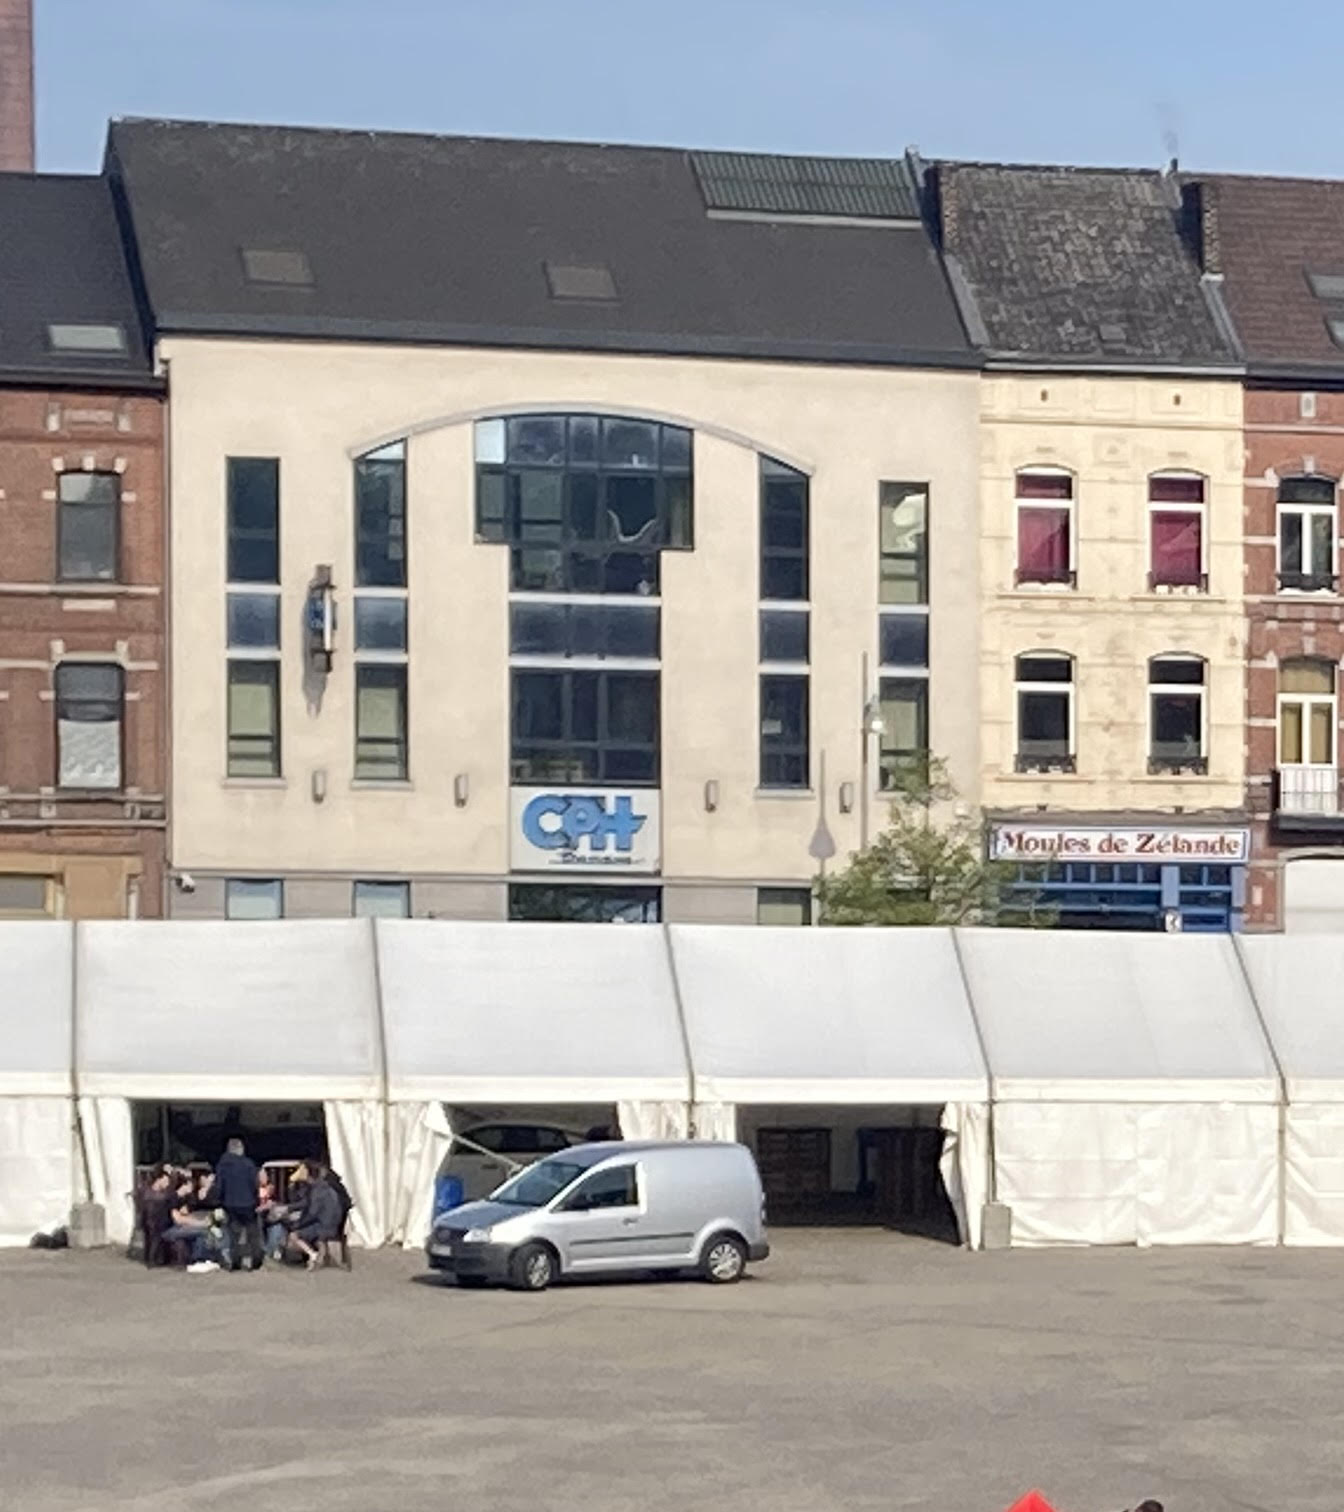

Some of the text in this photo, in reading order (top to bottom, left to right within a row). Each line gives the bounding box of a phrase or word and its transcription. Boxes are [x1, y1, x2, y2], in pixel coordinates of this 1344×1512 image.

[522, 794, 647, 851] CPH
[1004, 830, 1240, 856] Moules de Zélande
